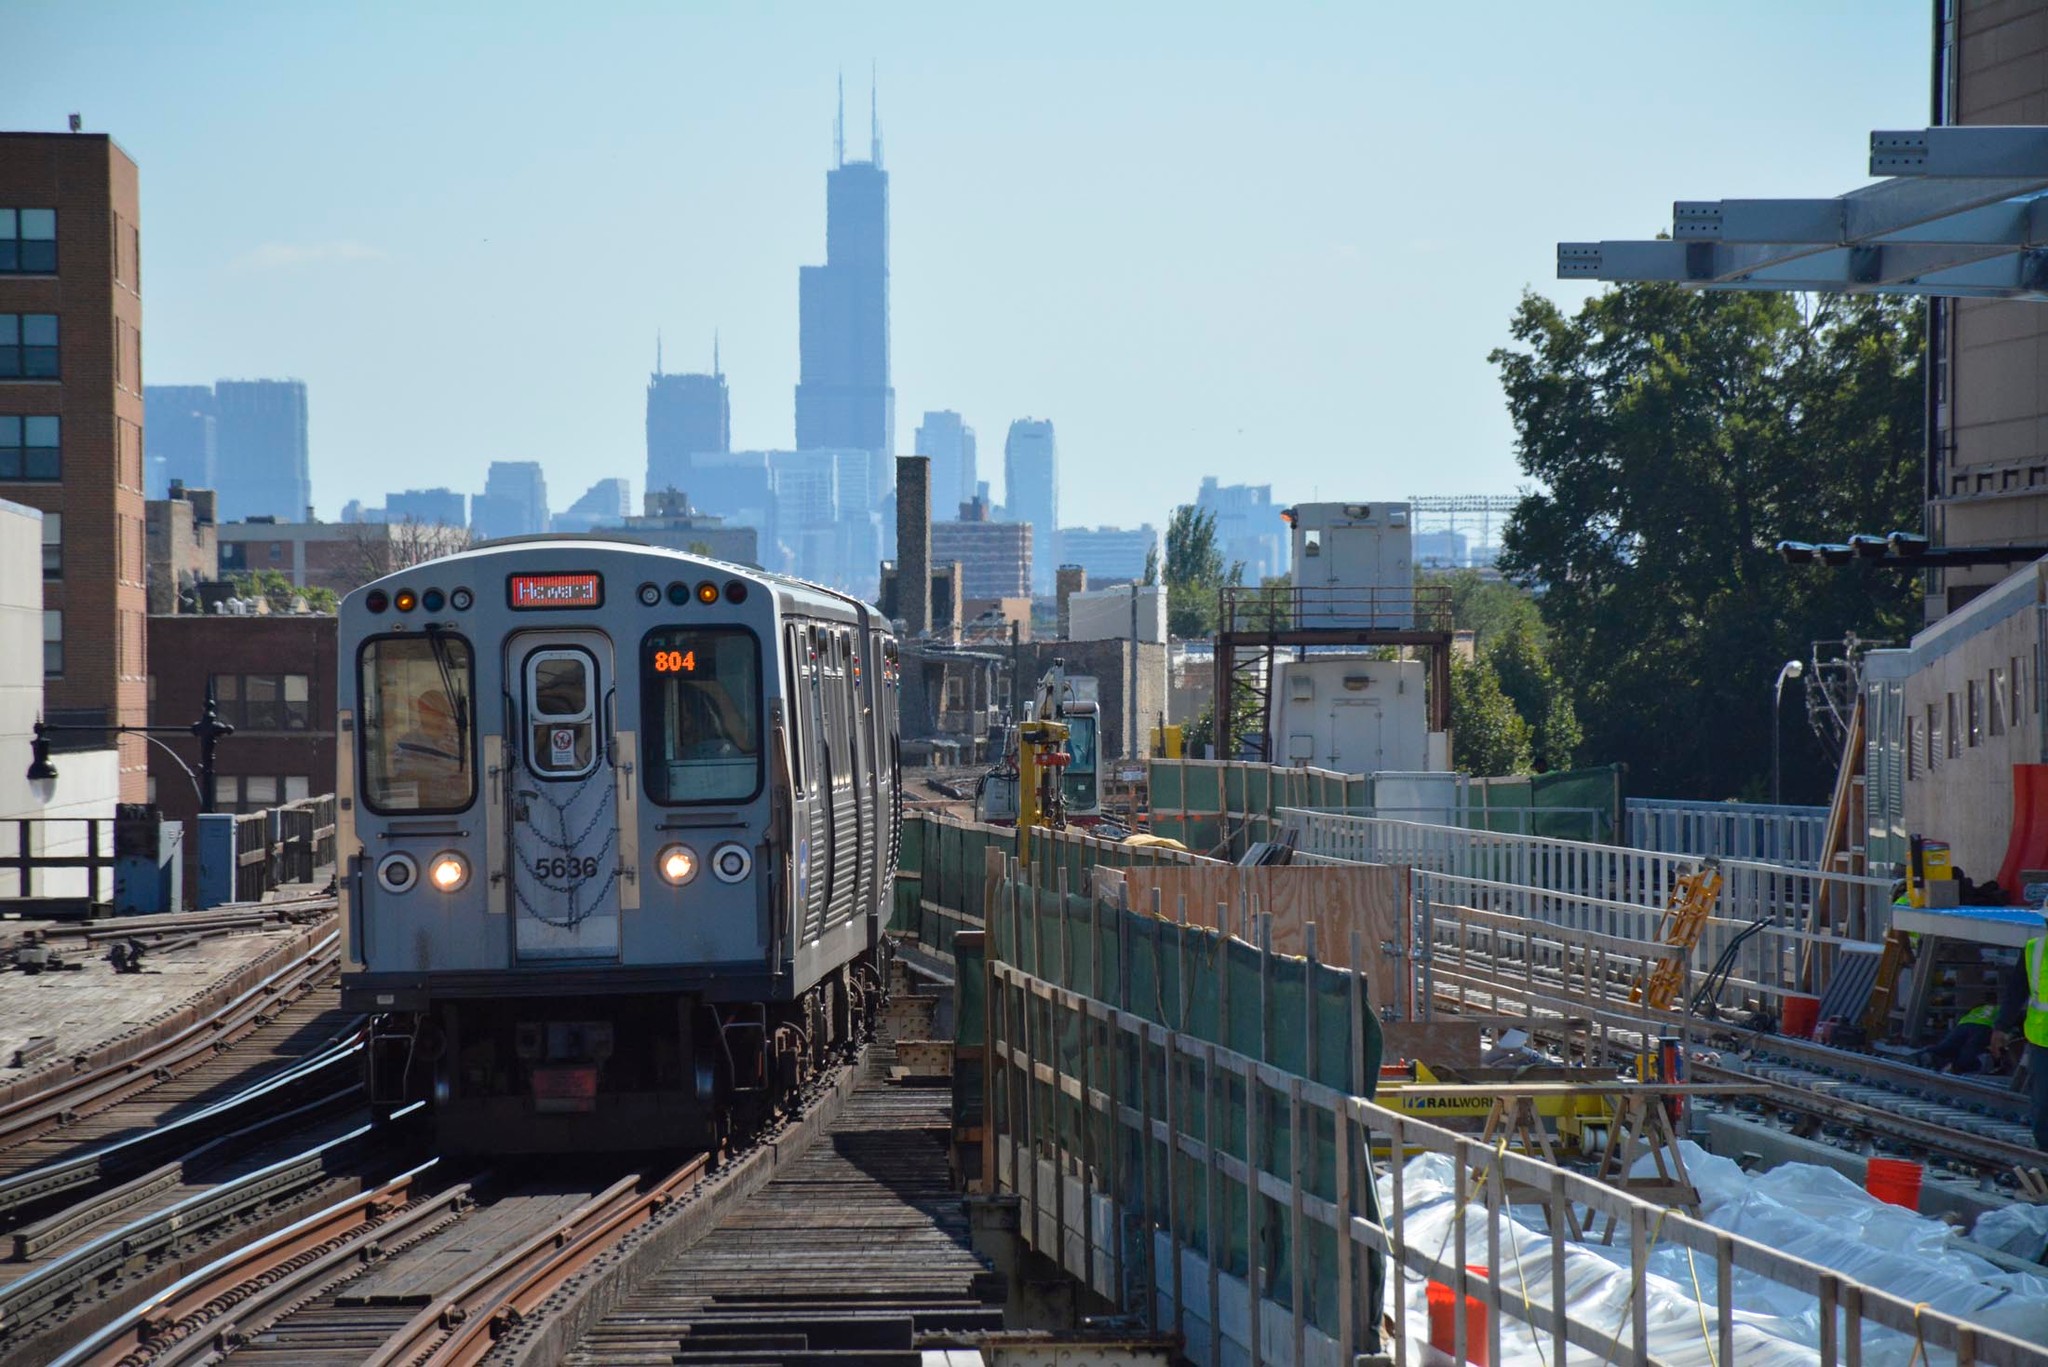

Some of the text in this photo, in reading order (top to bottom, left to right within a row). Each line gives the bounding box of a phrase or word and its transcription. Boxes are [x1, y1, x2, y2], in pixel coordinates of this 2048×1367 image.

[519, 580, 593, 600] Howad
[655, 651, 695, 671] 804
[536, 857, 598, 879] 5636
